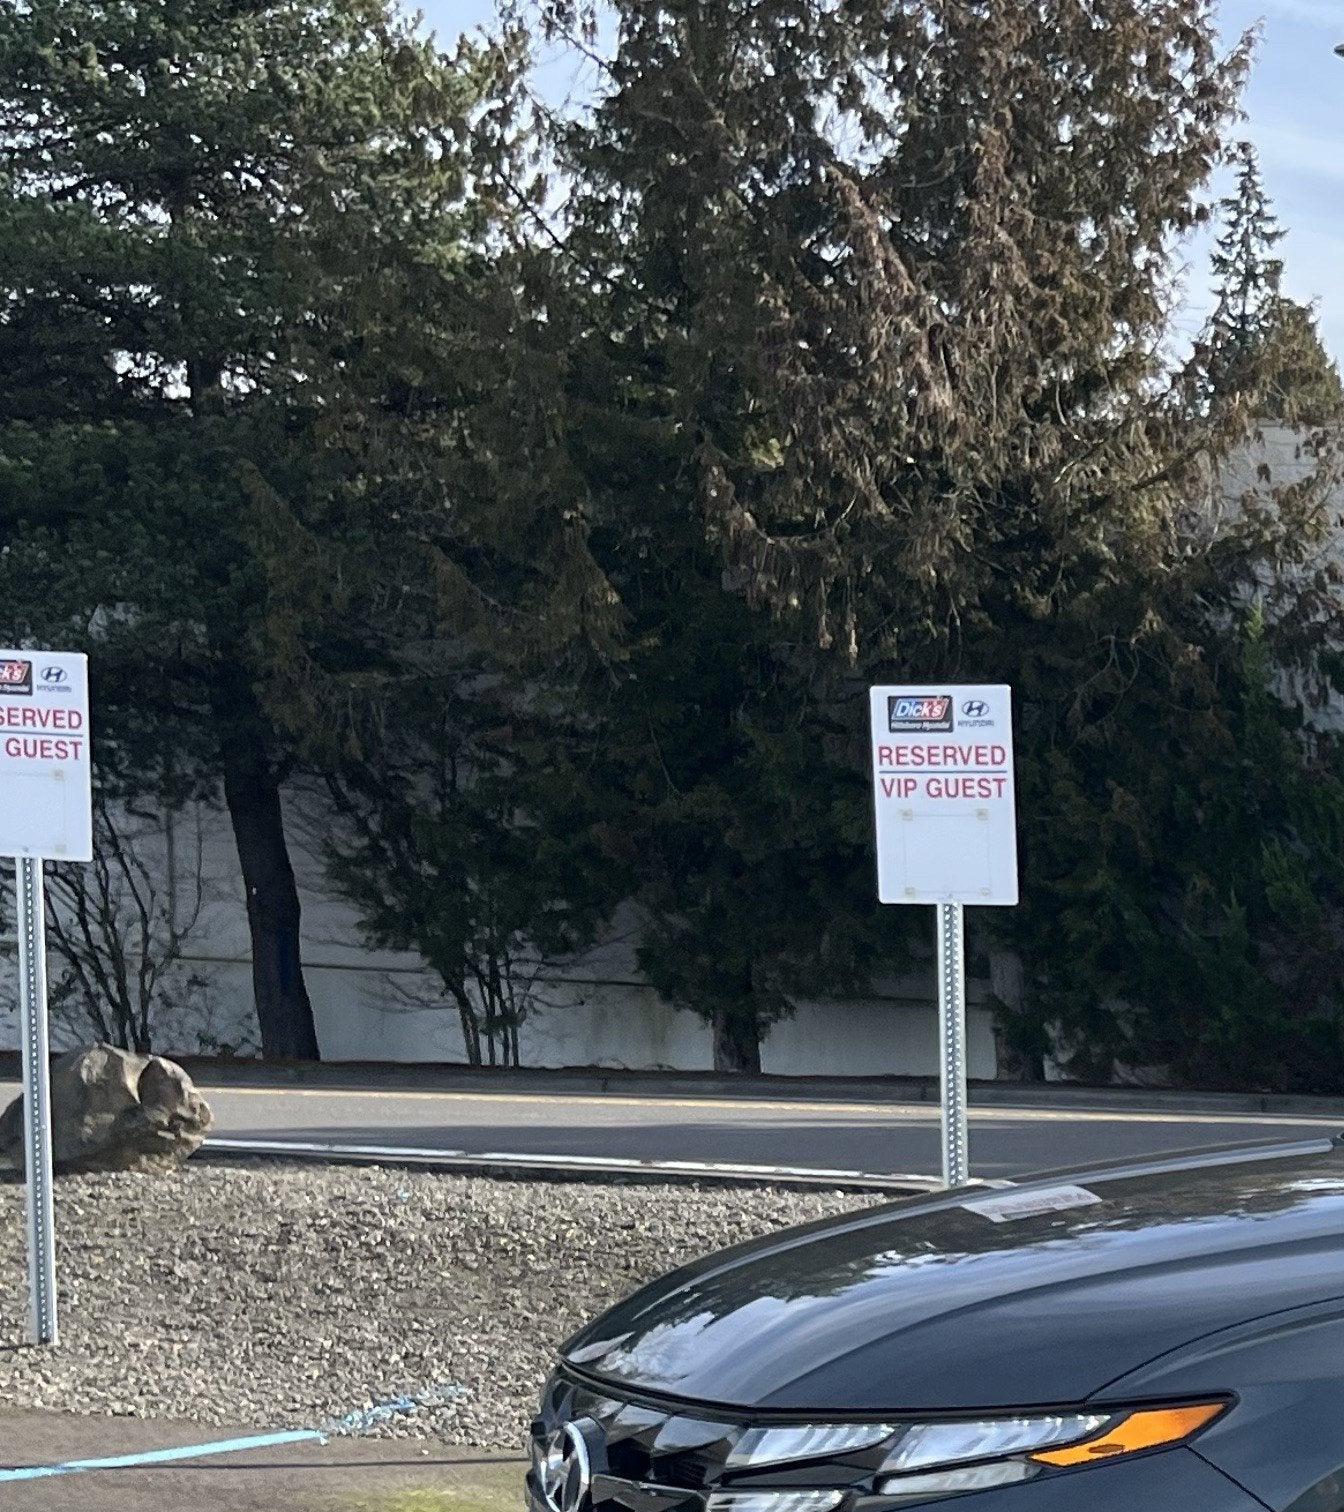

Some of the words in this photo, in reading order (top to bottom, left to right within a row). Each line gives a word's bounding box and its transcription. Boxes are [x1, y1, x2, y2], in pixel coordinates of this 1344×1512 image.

[5, 736, 83, 761] GUEST
[878, 745, 1006, 766] RESERVED
[880, 777, 917, 798] VIP
[926, 778, 1008, 798] GUEST
